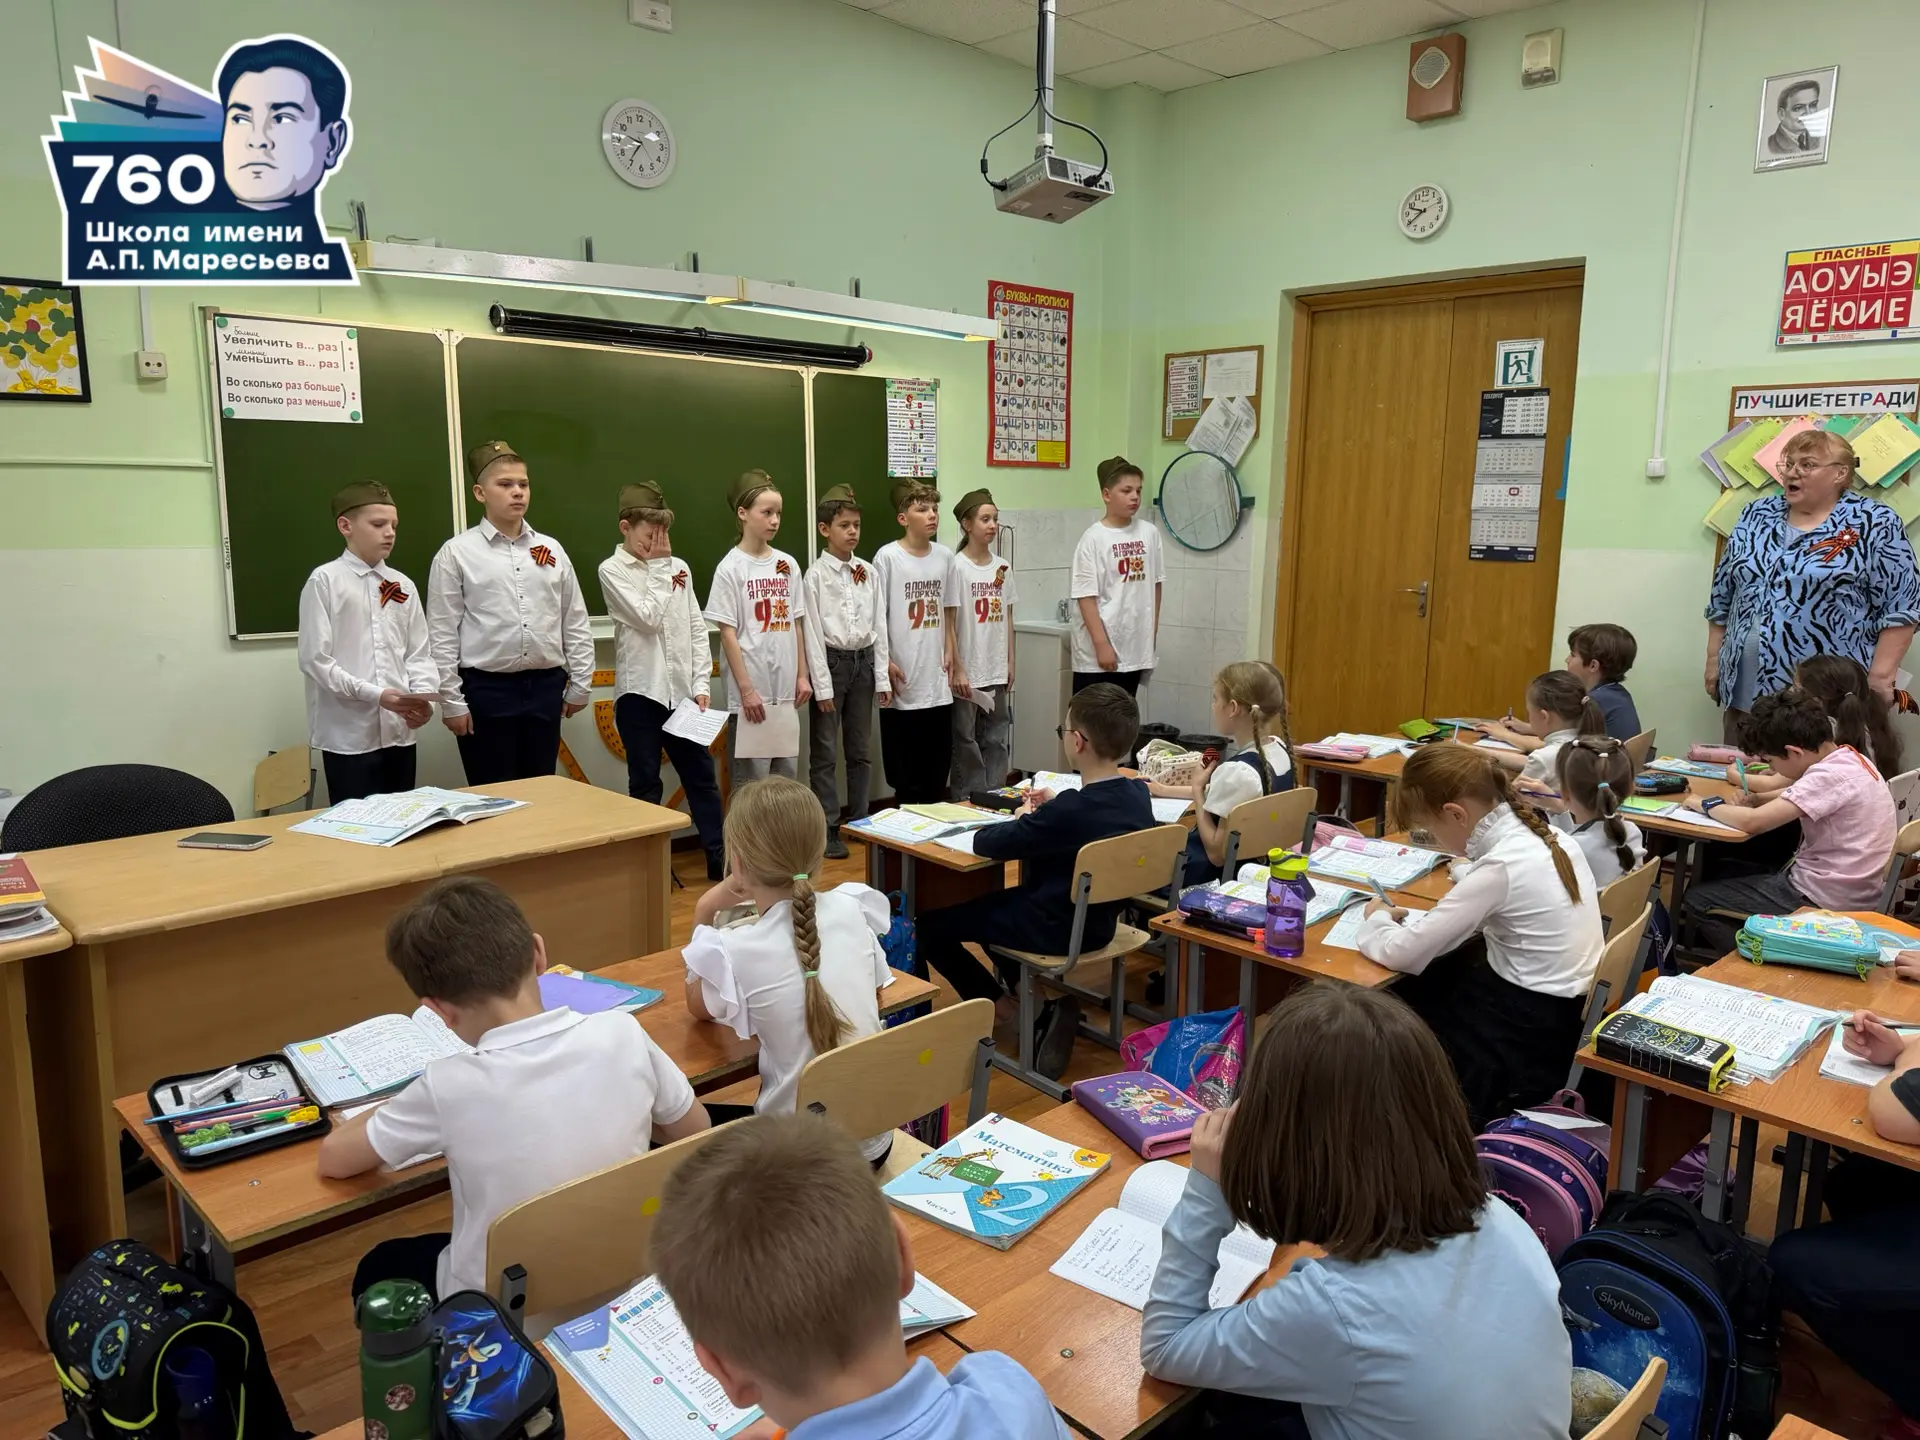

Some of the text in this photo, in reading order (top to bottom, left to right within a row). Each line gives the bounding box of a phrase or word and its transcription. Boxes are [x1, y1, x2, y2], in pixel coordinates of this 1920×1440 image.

[626, 116, 632, 124] 11
[636, 114, 644, 123] 12
[648, 120, 652, 128] 1
[620, 123, 627, 132] 10
[620, 148, 626, 156] 8
[659, 143, 664, 151] 3
[638, 164, 644, 172] 6
[649, 162, 655, 171] 5
[1814, 244, 1891, 262] ГЛАСНЫЕ
[223, 333, 293, 348] Увеличить
[317, 343, 338, 353] раз
[224, 351, 294, 366] Уменьшить
[319, 360, 339, 370] раз
[226, 376, 341, 393] Во сколько раз больше
[227, 393, 342, 409] Во сколько раз меньше
[1118, 557, 1130, 582] 9
[747, 579, 754, 592] Я
[905, 581, 911, 592] Я
[971, 582, 976, 591] Я
[749, 590, 754, 600] Я
[905, 591, 911, 600] Я
[755, 598, 771, 633] 9
[908, 599, 925, 630] 9
[975, 598, 989, 623] 9
[973, 1130, 1073, 1176] Математика
[925, 1199, 951, 1215] Часть
[977, 1185, 1050, 1227] 2
[1599, 1291, 1651, 1325] SkyName
